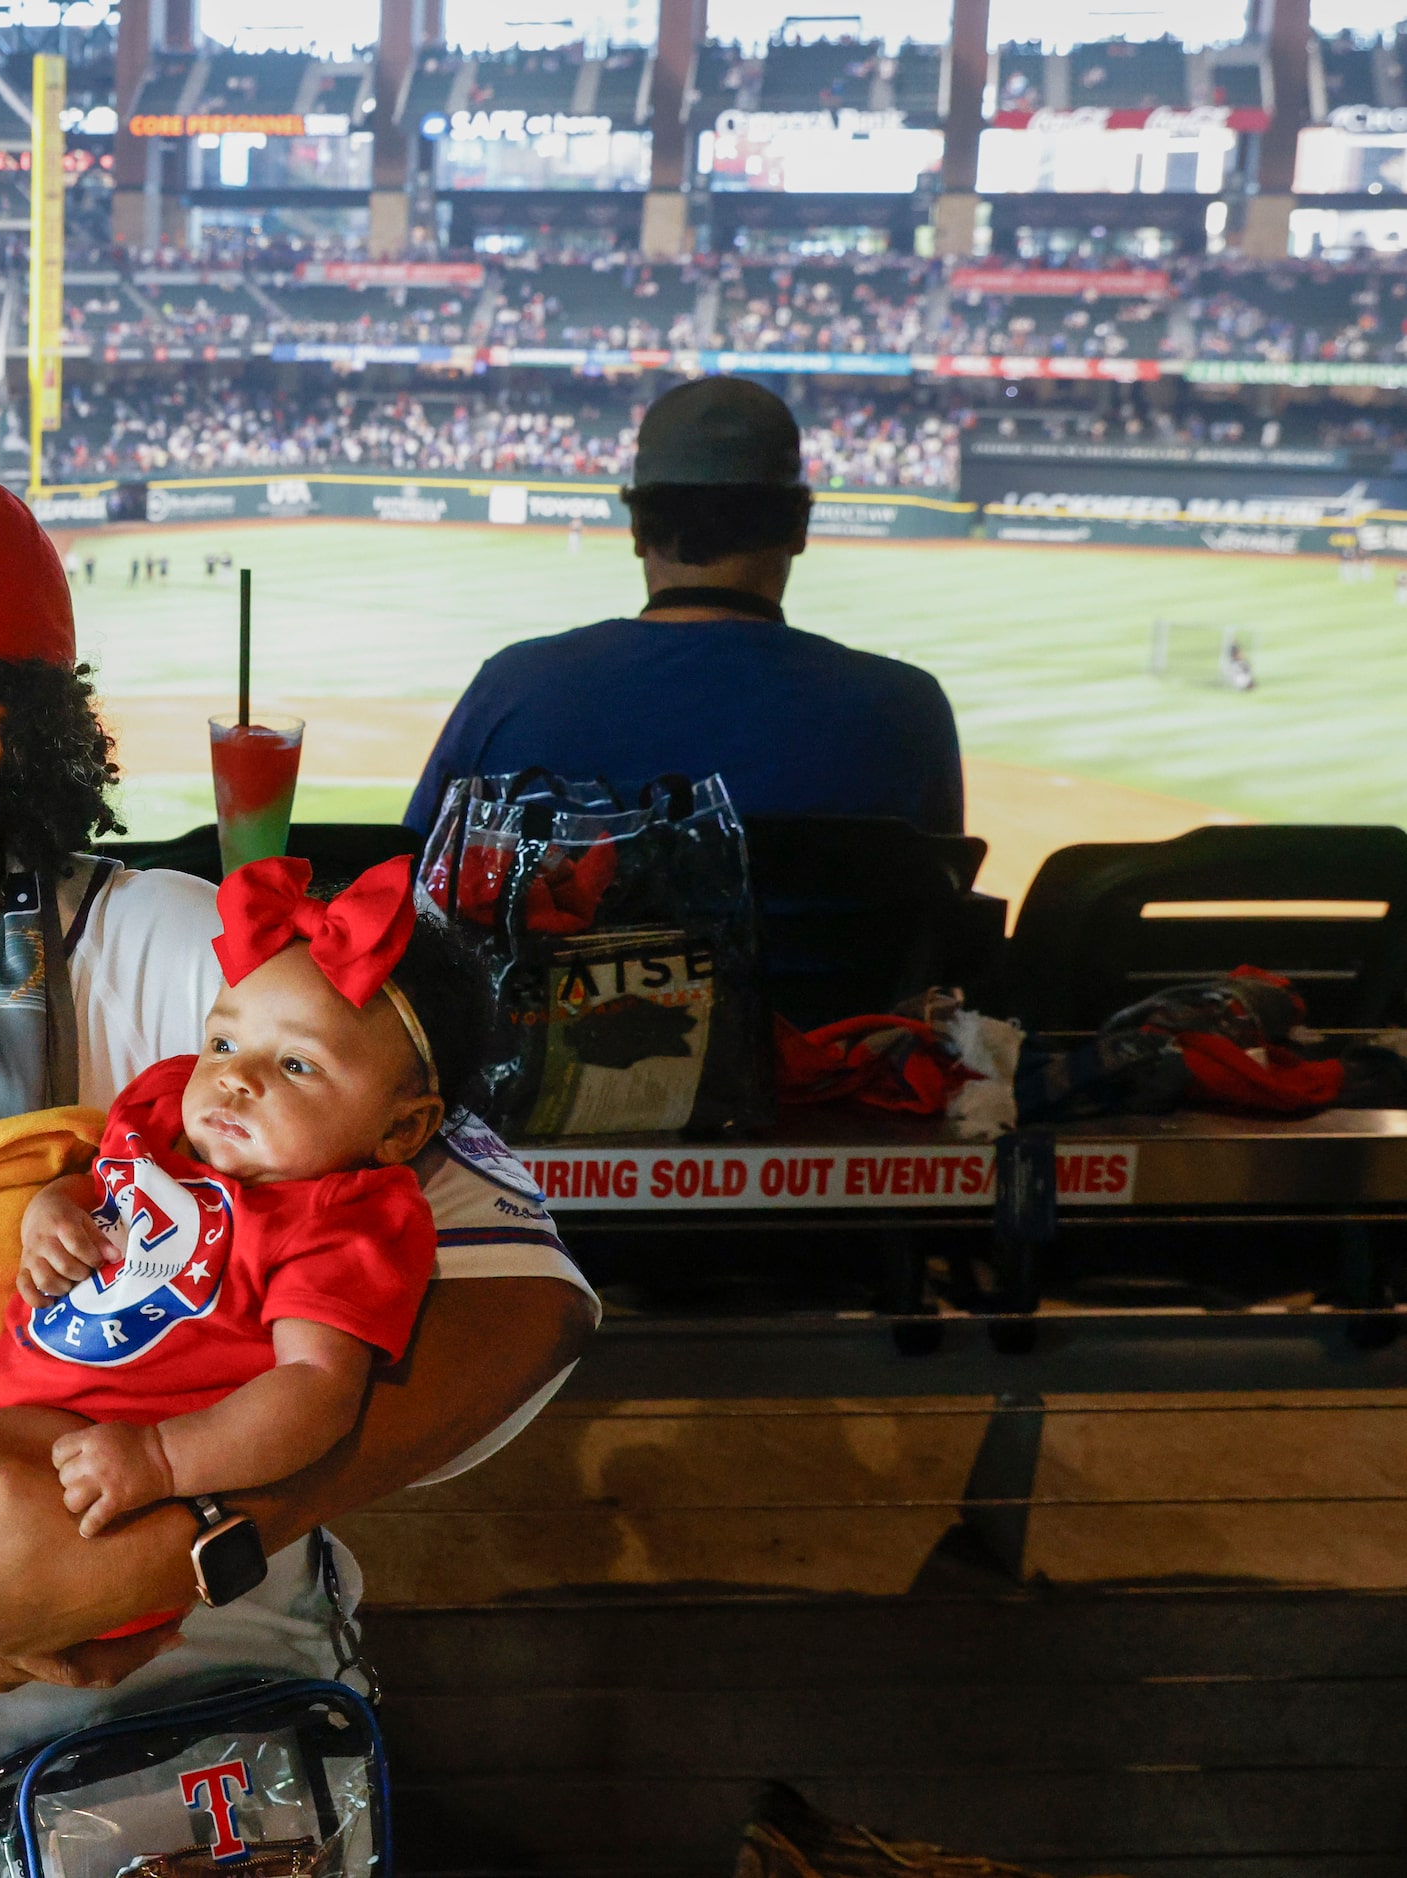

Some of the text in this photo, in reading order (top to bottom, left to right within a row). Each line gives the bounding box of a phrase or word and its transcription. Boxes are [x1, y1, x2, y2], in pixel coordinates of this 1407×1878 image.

[130, 115, 184, 136] CORE
[450, 110, 527, 141] SAFE
[529, 496, 611, 519] TOYOTA
[649, 1159, 747, 1198] SOLD
[760, 1157, 833, 1197] OUT
[178, 1759, 254, 1865] T
